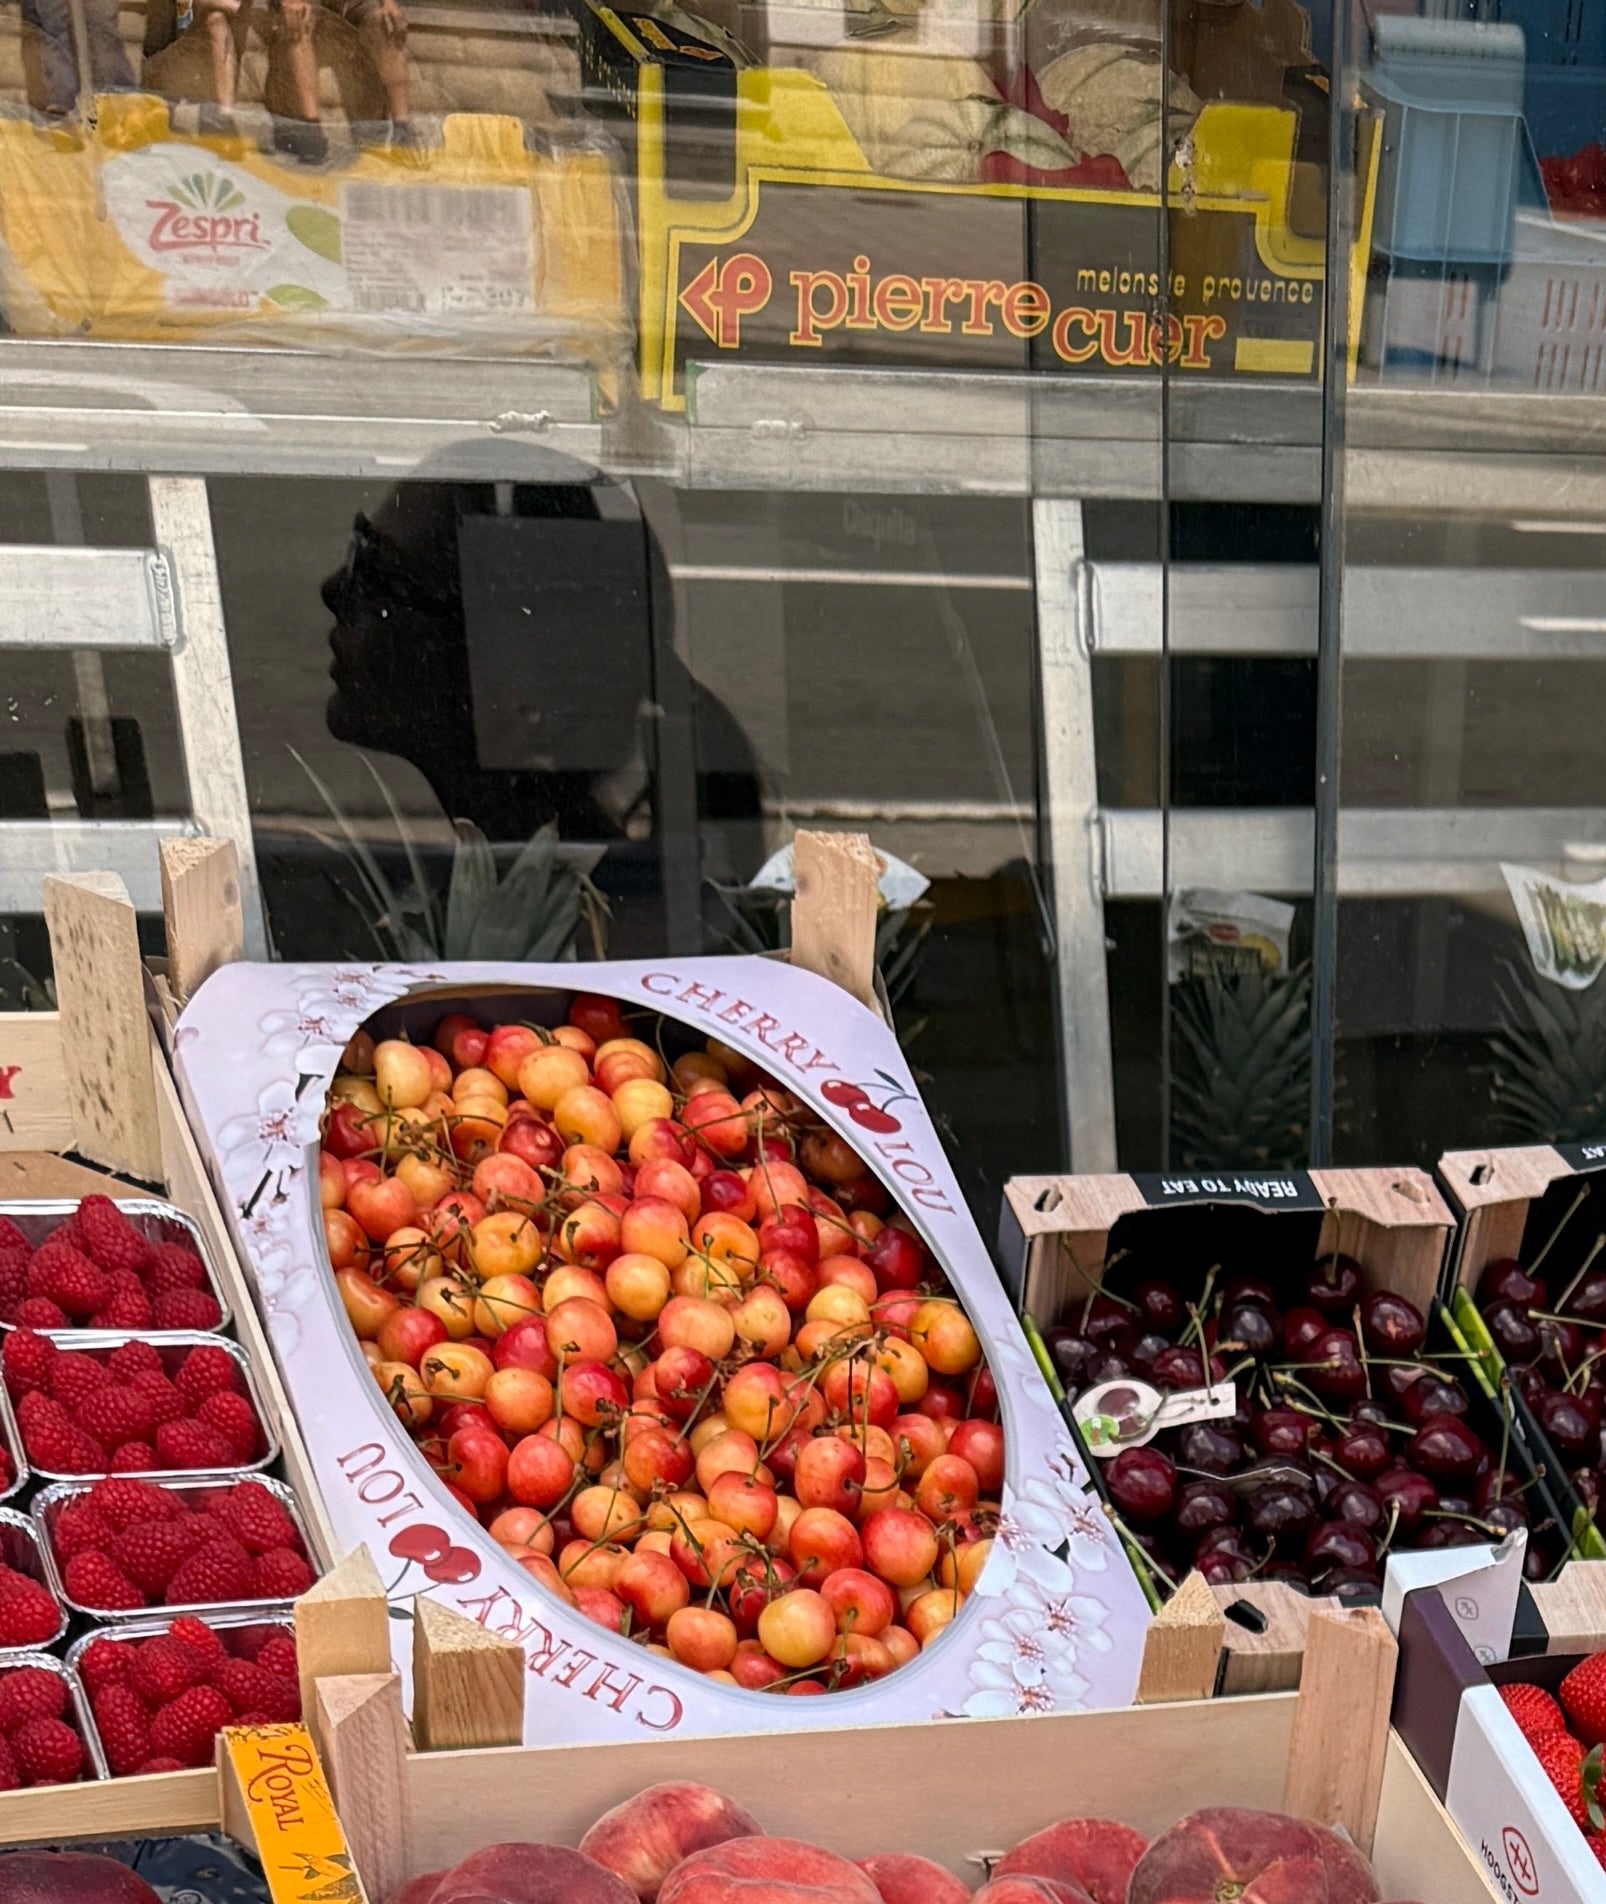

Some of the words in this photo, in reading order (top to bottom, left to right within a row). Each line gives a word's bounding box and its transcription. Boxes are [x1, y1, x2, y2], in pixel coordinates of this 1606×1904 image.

[145, 199, 271, 253] Zespri
[789, 254, 1051, 347] pierre
[1052, 306, 1227, 369] cuer
[1076, 266, 1159, 297] melons
[640, 972, 841, 1075] CHERRY
[873, 1139, 957, 1216] LOU
[1160, 1178, 1200, 1196] EAT
[1200, 1177, 1232, 1194] TO
[1232, 1177, 1299, 1199] READY
[336, 1442, 425, 1529] LOU
[456, 1585, 684, 1732] CHERRY
[247, 1744, 314, 1832] ROYAL
